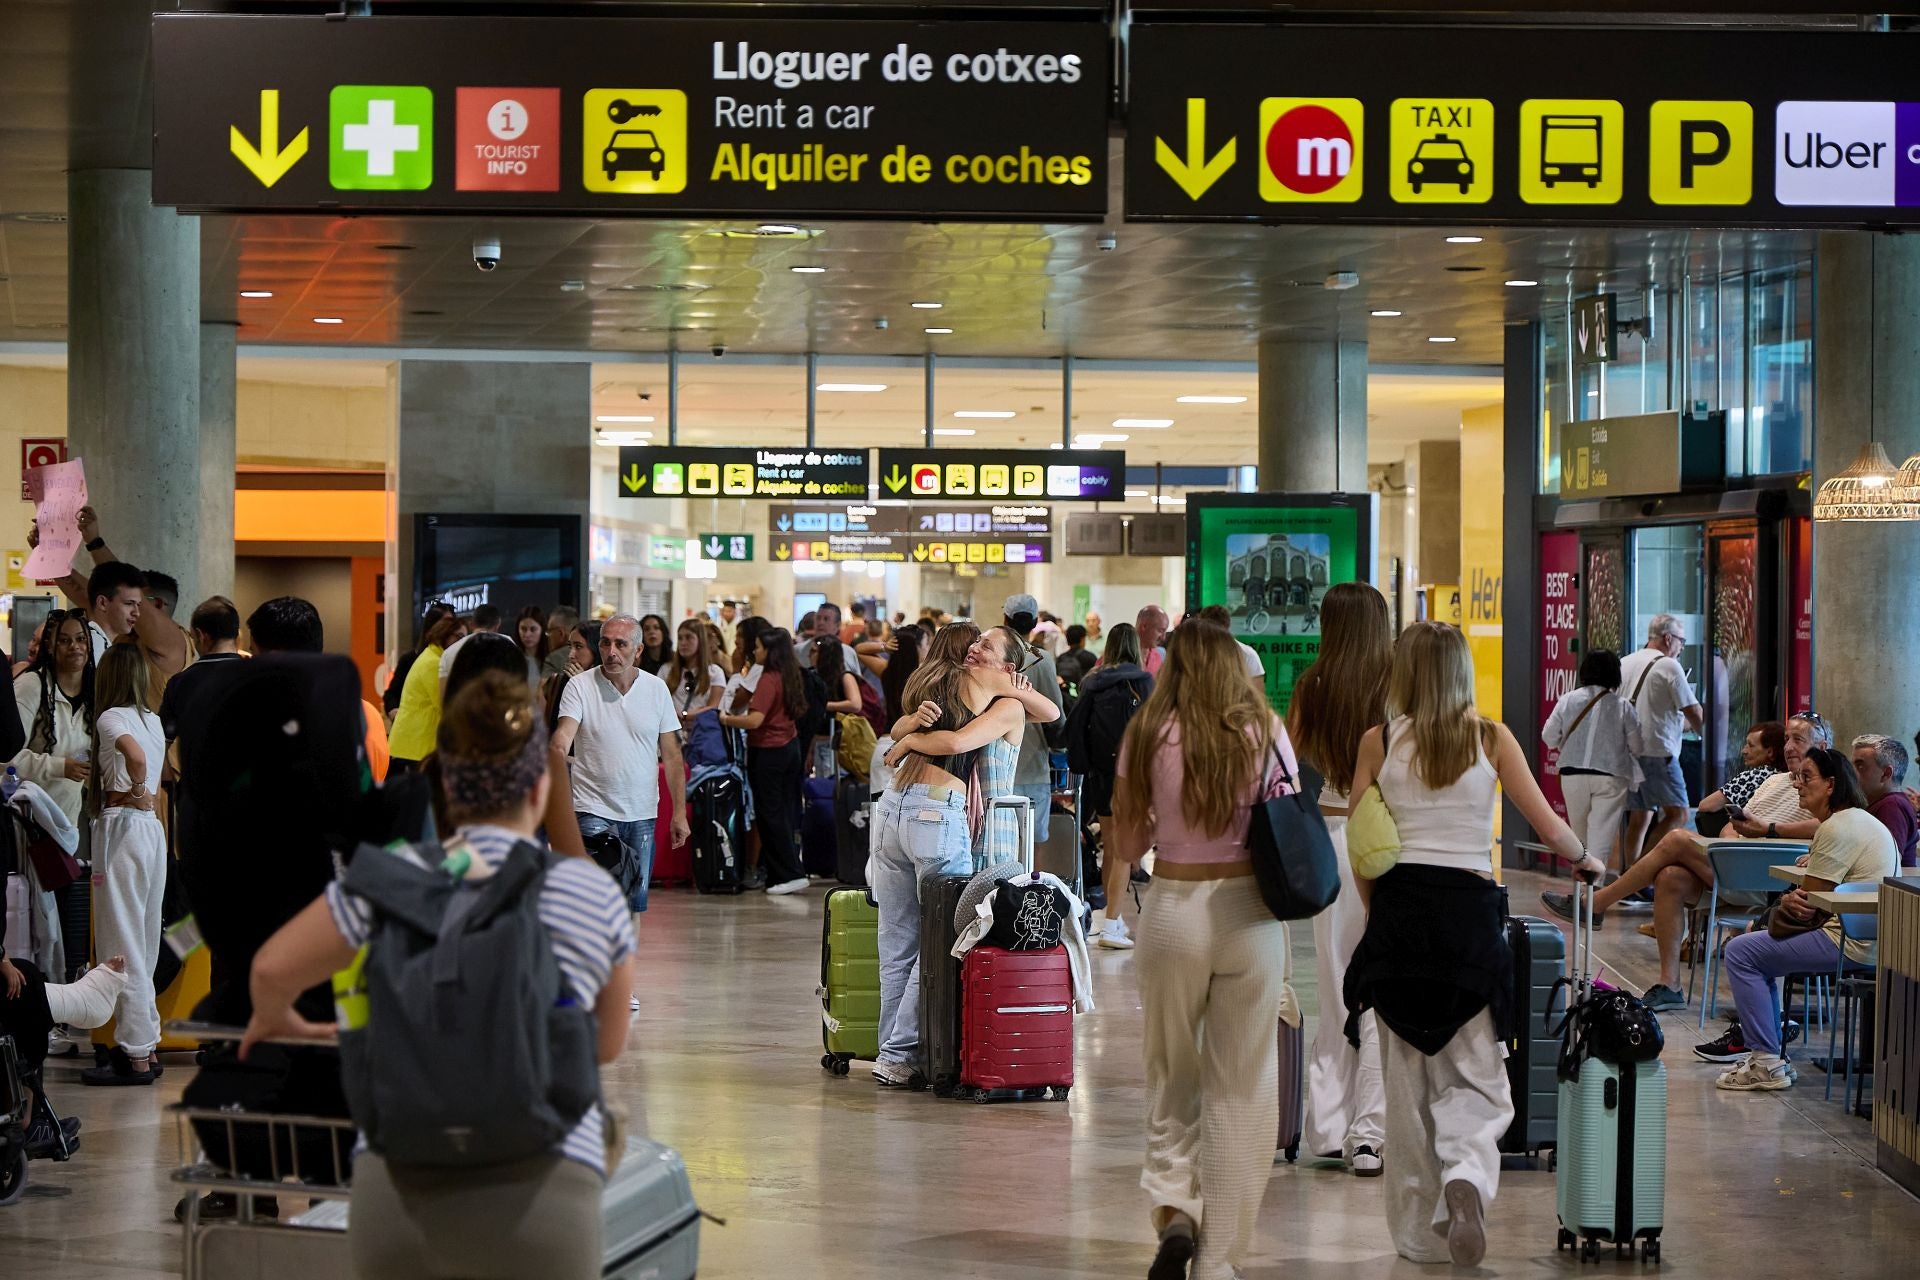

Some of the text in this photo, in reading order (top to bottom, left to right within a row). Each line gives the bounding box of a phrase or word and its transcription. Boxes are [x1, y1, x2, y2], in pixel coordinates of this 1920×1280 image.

[713, 41, 1082, 88] Lloguer de cotxes
[716, 97, 874, 129] Rent a car
[1411, 106, 1472, 127] TAXI
[475, 145, 540, 160] TOURIST
[1296, 136, 1352, 177] m
[1679, 120, 1732, 189] P
[1783, 132, 1886, 170] Uber
[487, 161, 527, 175] INFO
[710, 143, 1092, 191] Alquiler de coches
[757, 451, 862, 467] Lloguer de cotxes
[758, 467, 805, 478] Rent a car
[1023, 471, 1035, 488] P
[1592, 470, 1607, 486] Salida
[756, 480, 865, 496] Alquiler de coches
[1546, 573, 1569, 597] BEST
[1546, 604, 1575, 629] PLACE
[1271, 642, 1302, 654] BIKE
[1546, 636, 1559, 660] TO
[1546, 669, 1576, 702] WOW
